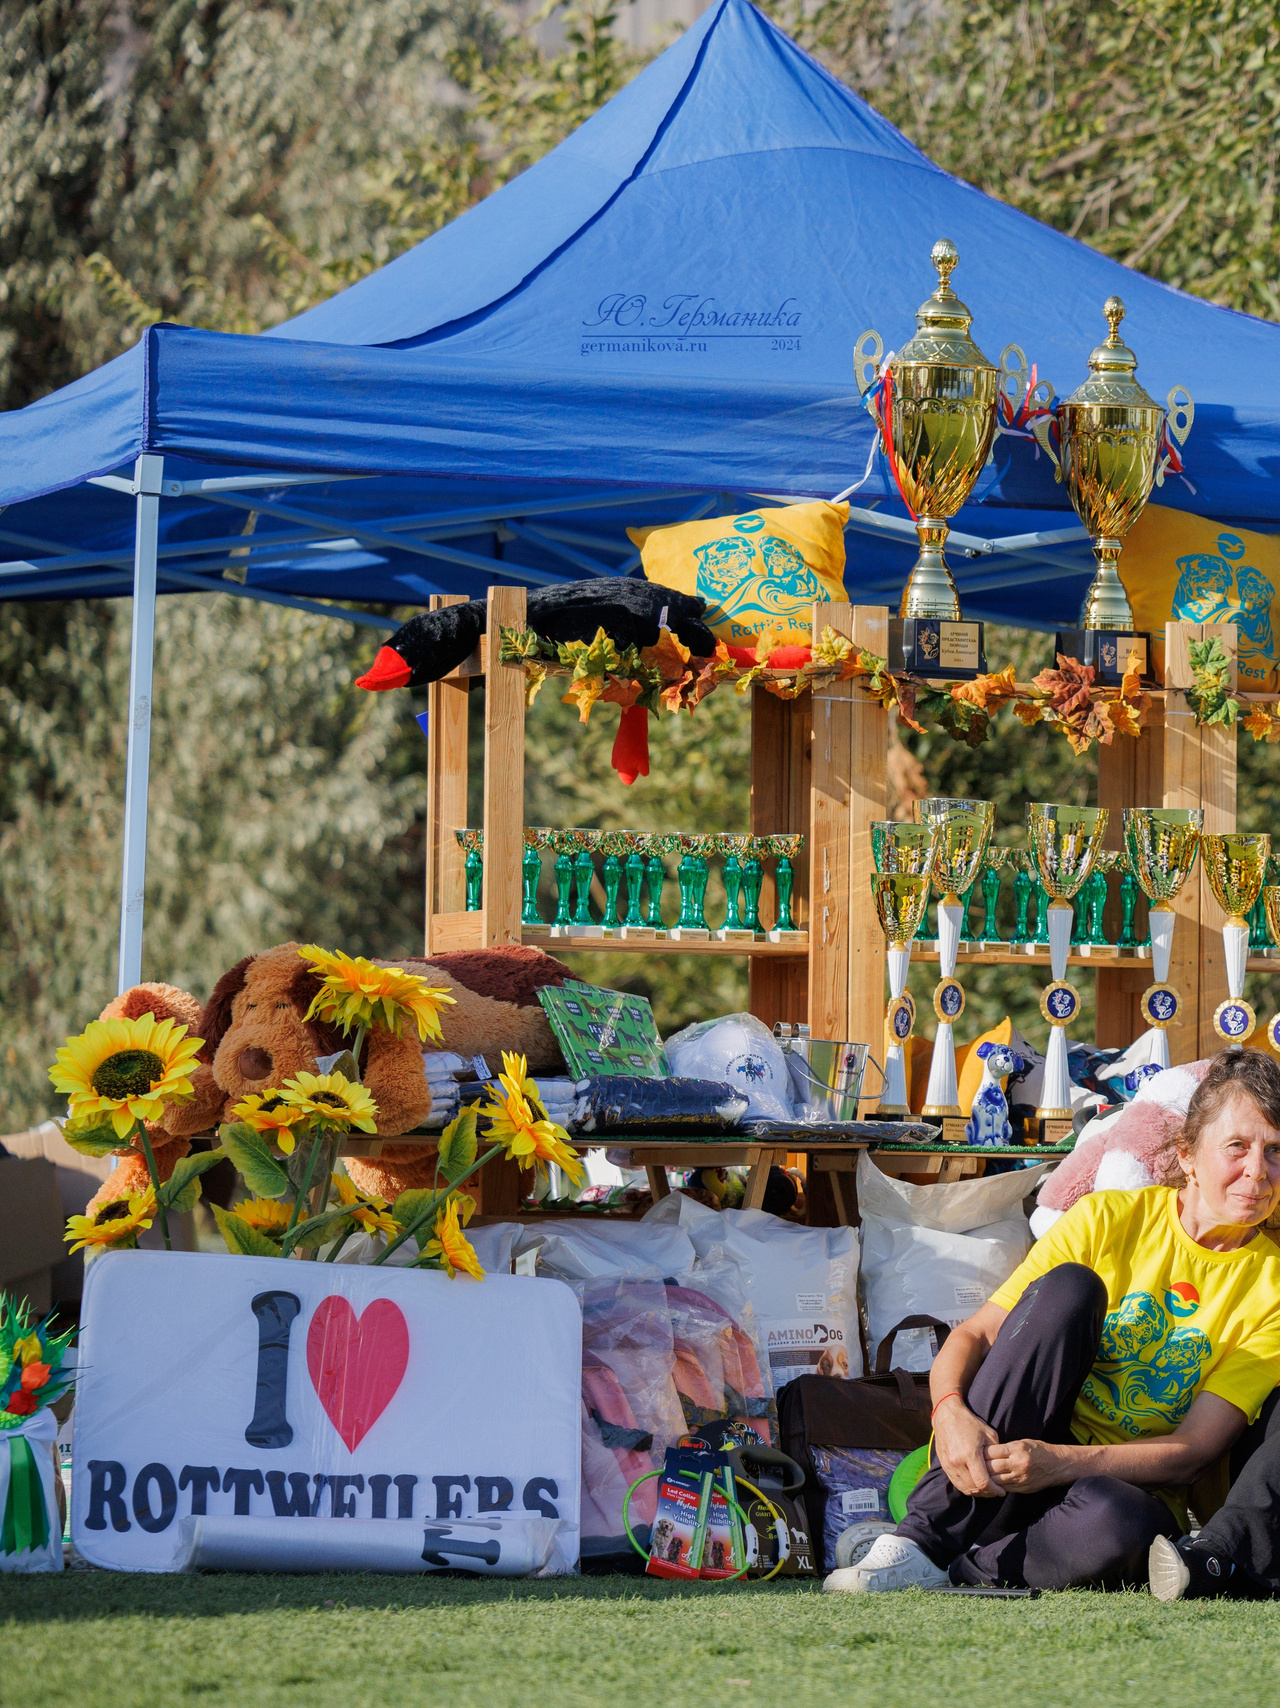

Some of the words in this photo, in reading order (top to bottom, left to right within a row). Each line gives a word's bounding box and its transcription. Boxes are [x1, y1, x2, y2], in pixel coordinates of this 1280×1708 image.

[787, 617, 813, 630] Res
[1237, 660, 1267, 680] Rest
[244, 1290, 302, 1449] I
[1081, 1380, 1117, 1422] Rotti's
[667, 1487, 679, 1495] Led
[678, 1490, 697, 1500] Collar
[676, 1499, 698, 1511] Nylon
[673, 1514, 702, 1528] Visibility
[680, 1510, 696, 1520] High
[712, 1511, 729, 1519] High
[796, 1555, 814, 1570] XL
